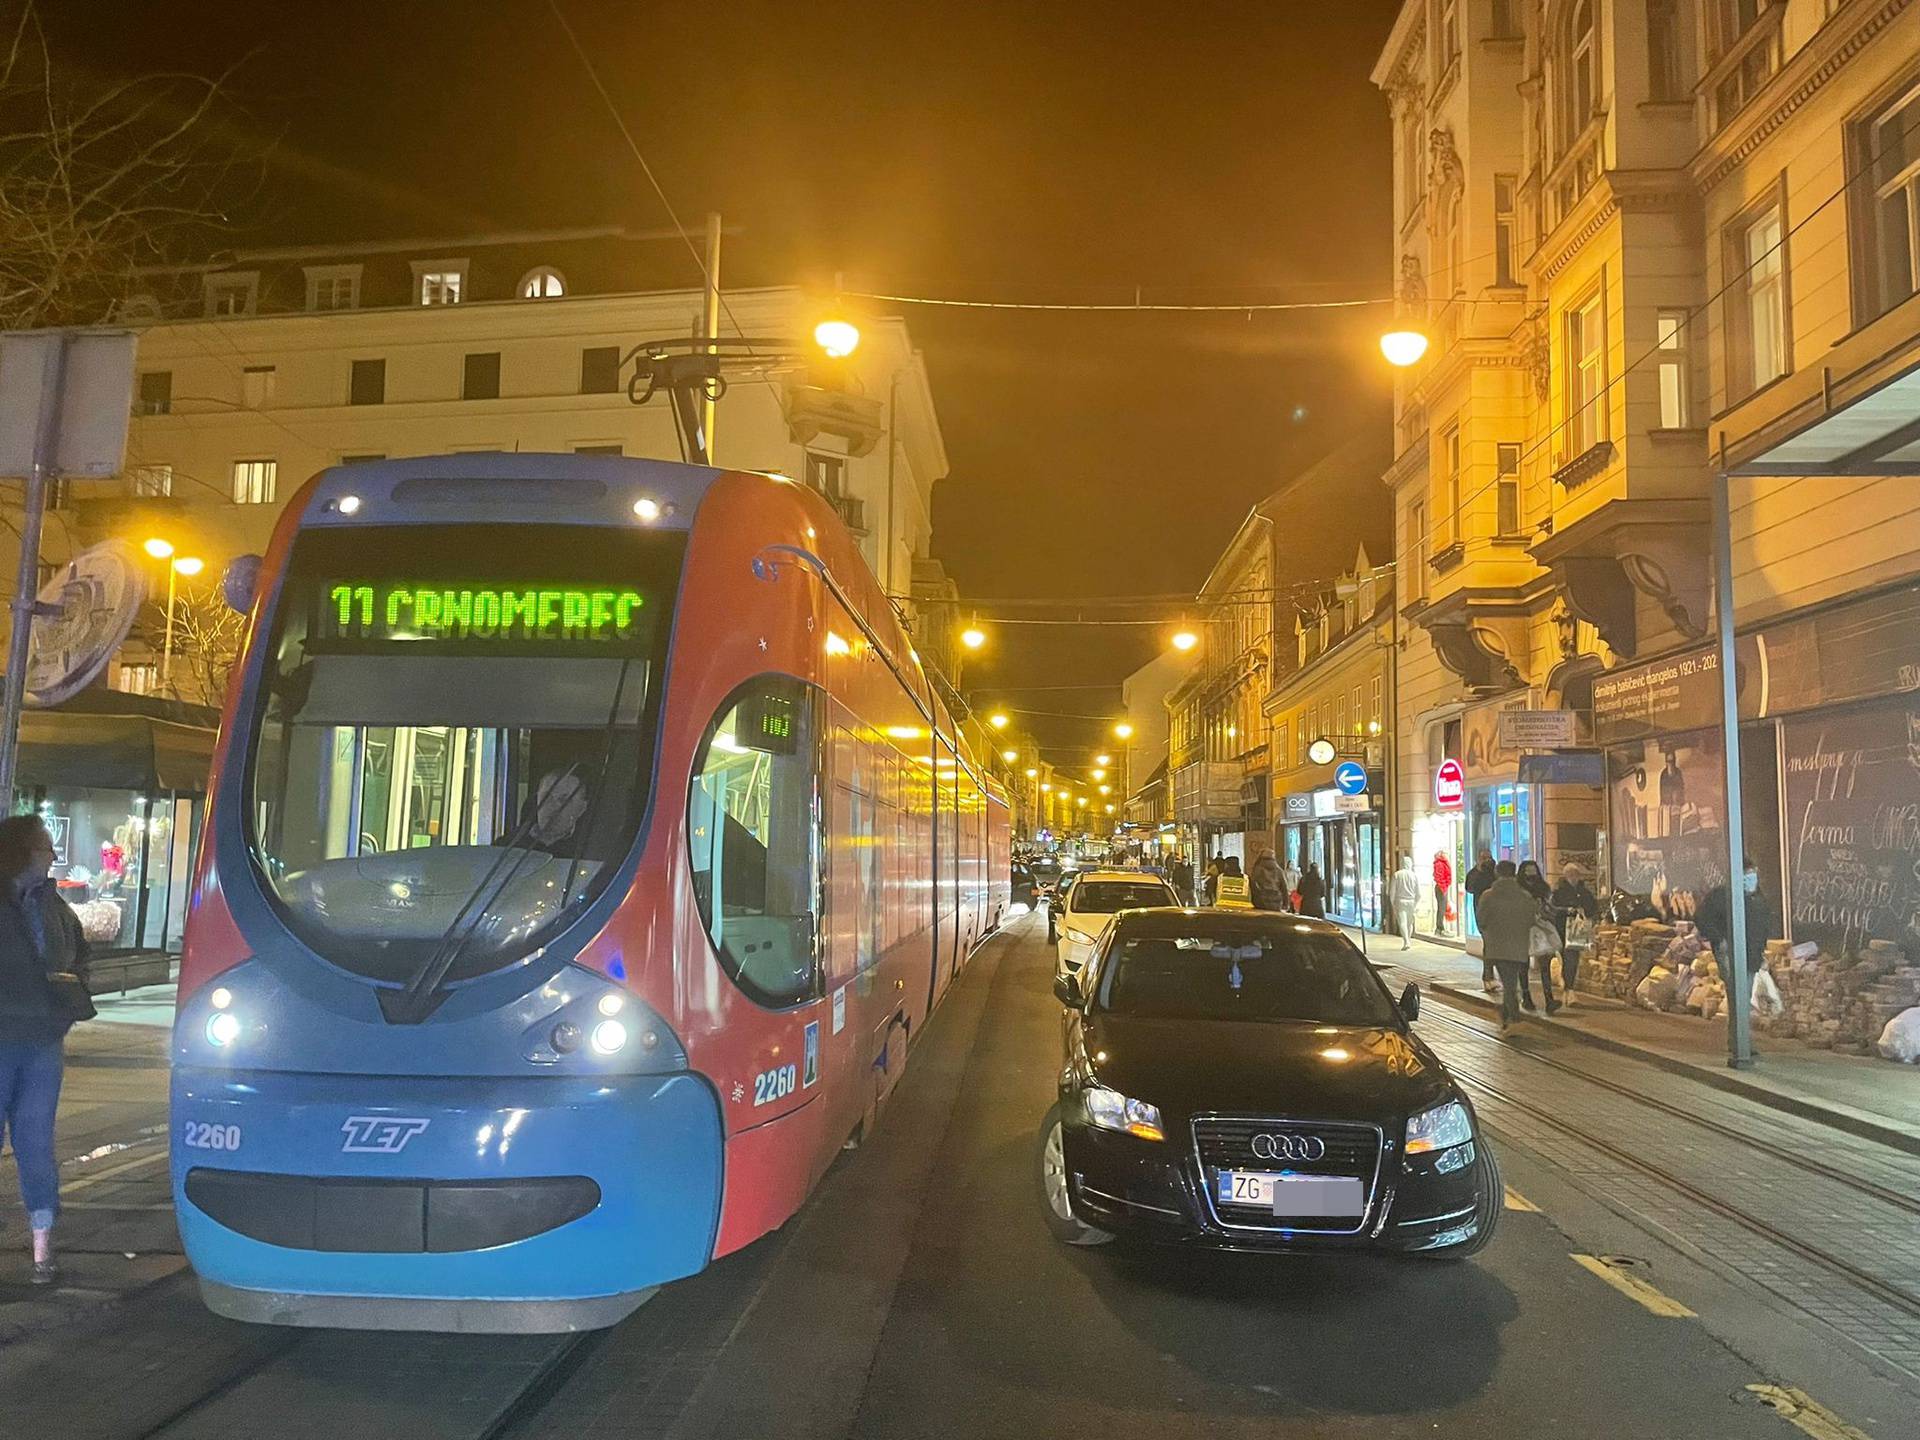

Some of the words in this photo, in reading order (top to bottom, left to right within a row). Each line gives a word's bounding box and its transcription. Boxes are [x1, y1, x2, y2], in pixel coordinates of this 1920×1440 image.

[331, 586, 374, 626] 11
[755, 1063, 797, 1107] 2260
[184, 1120, 241, 1151] 2260
[1235, 1177, 1259, 1199] ZG
